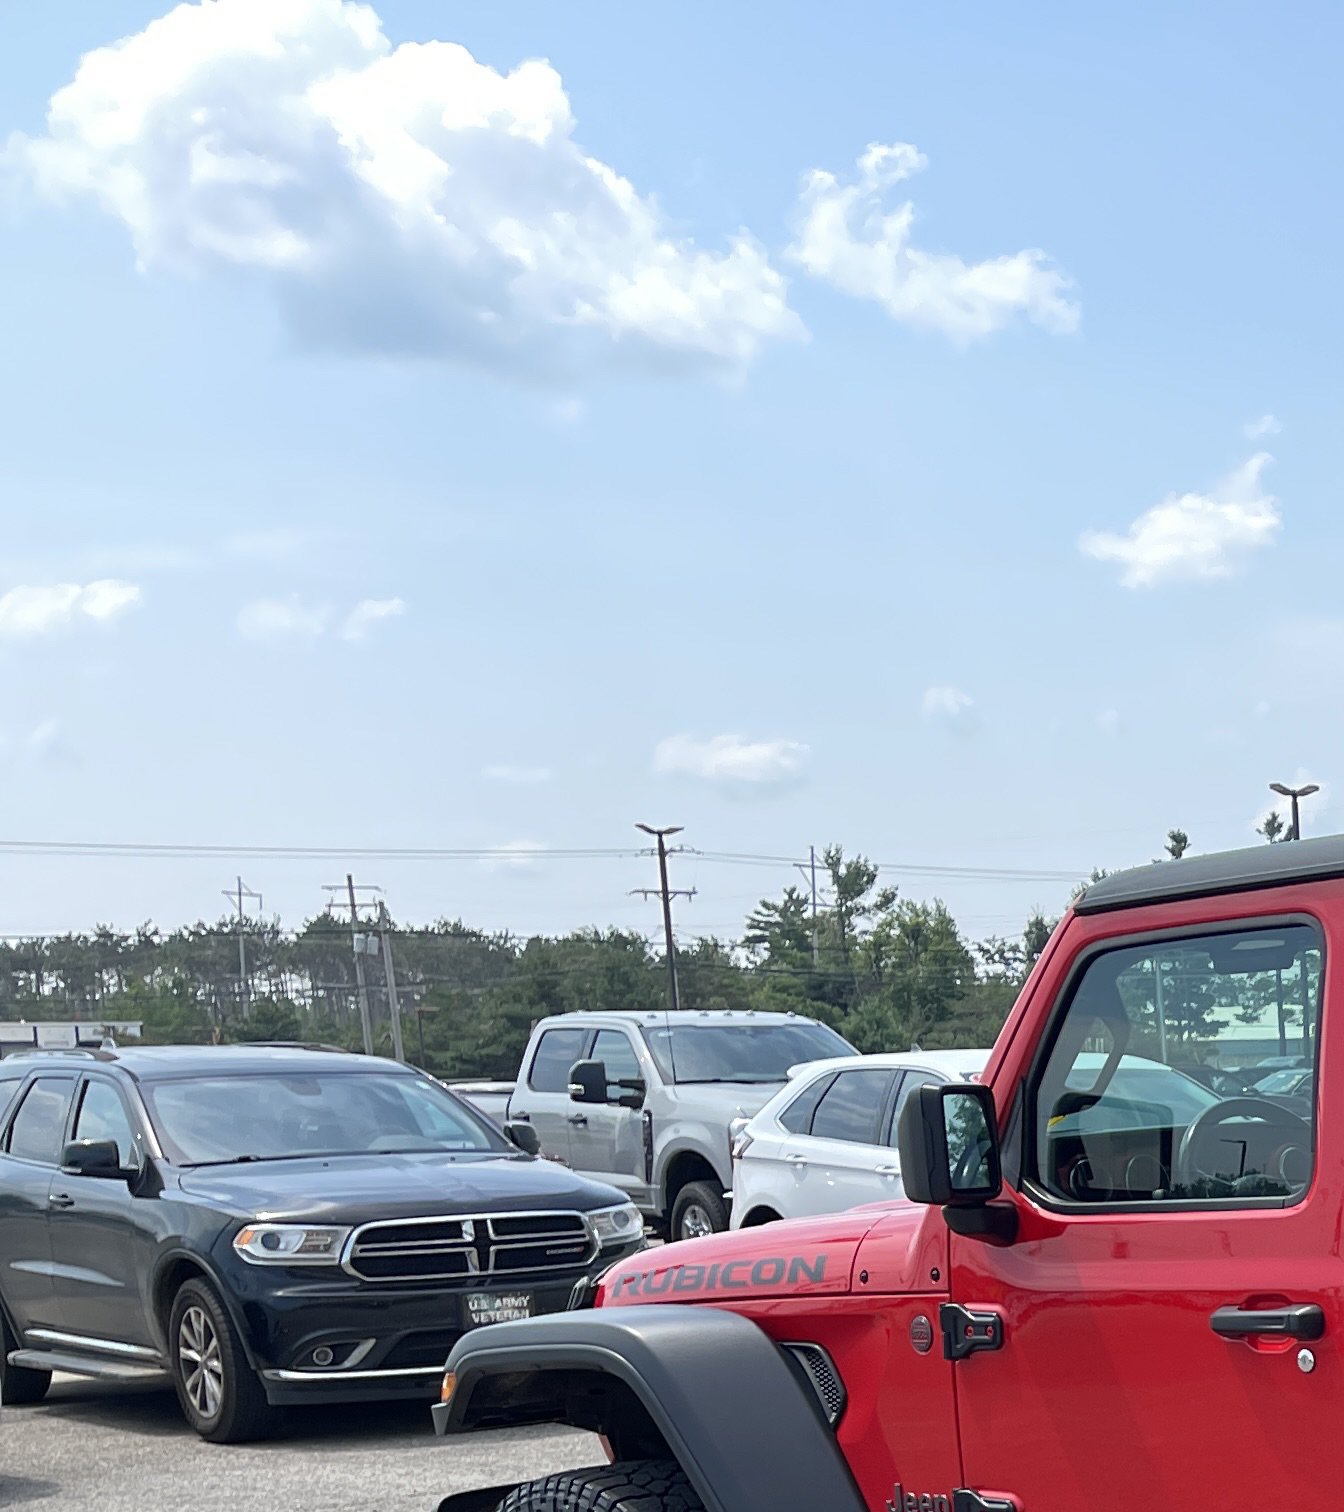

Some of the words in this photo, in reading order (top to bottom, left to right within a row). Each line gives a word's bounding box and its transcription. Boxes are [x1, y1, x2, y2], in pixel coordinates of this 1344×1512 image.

[611, 1253, 829, 1299] RUBICON
[494, 1295, 530, 1310] ARMY
[471, 1308, 530, 1324] VETERAN
